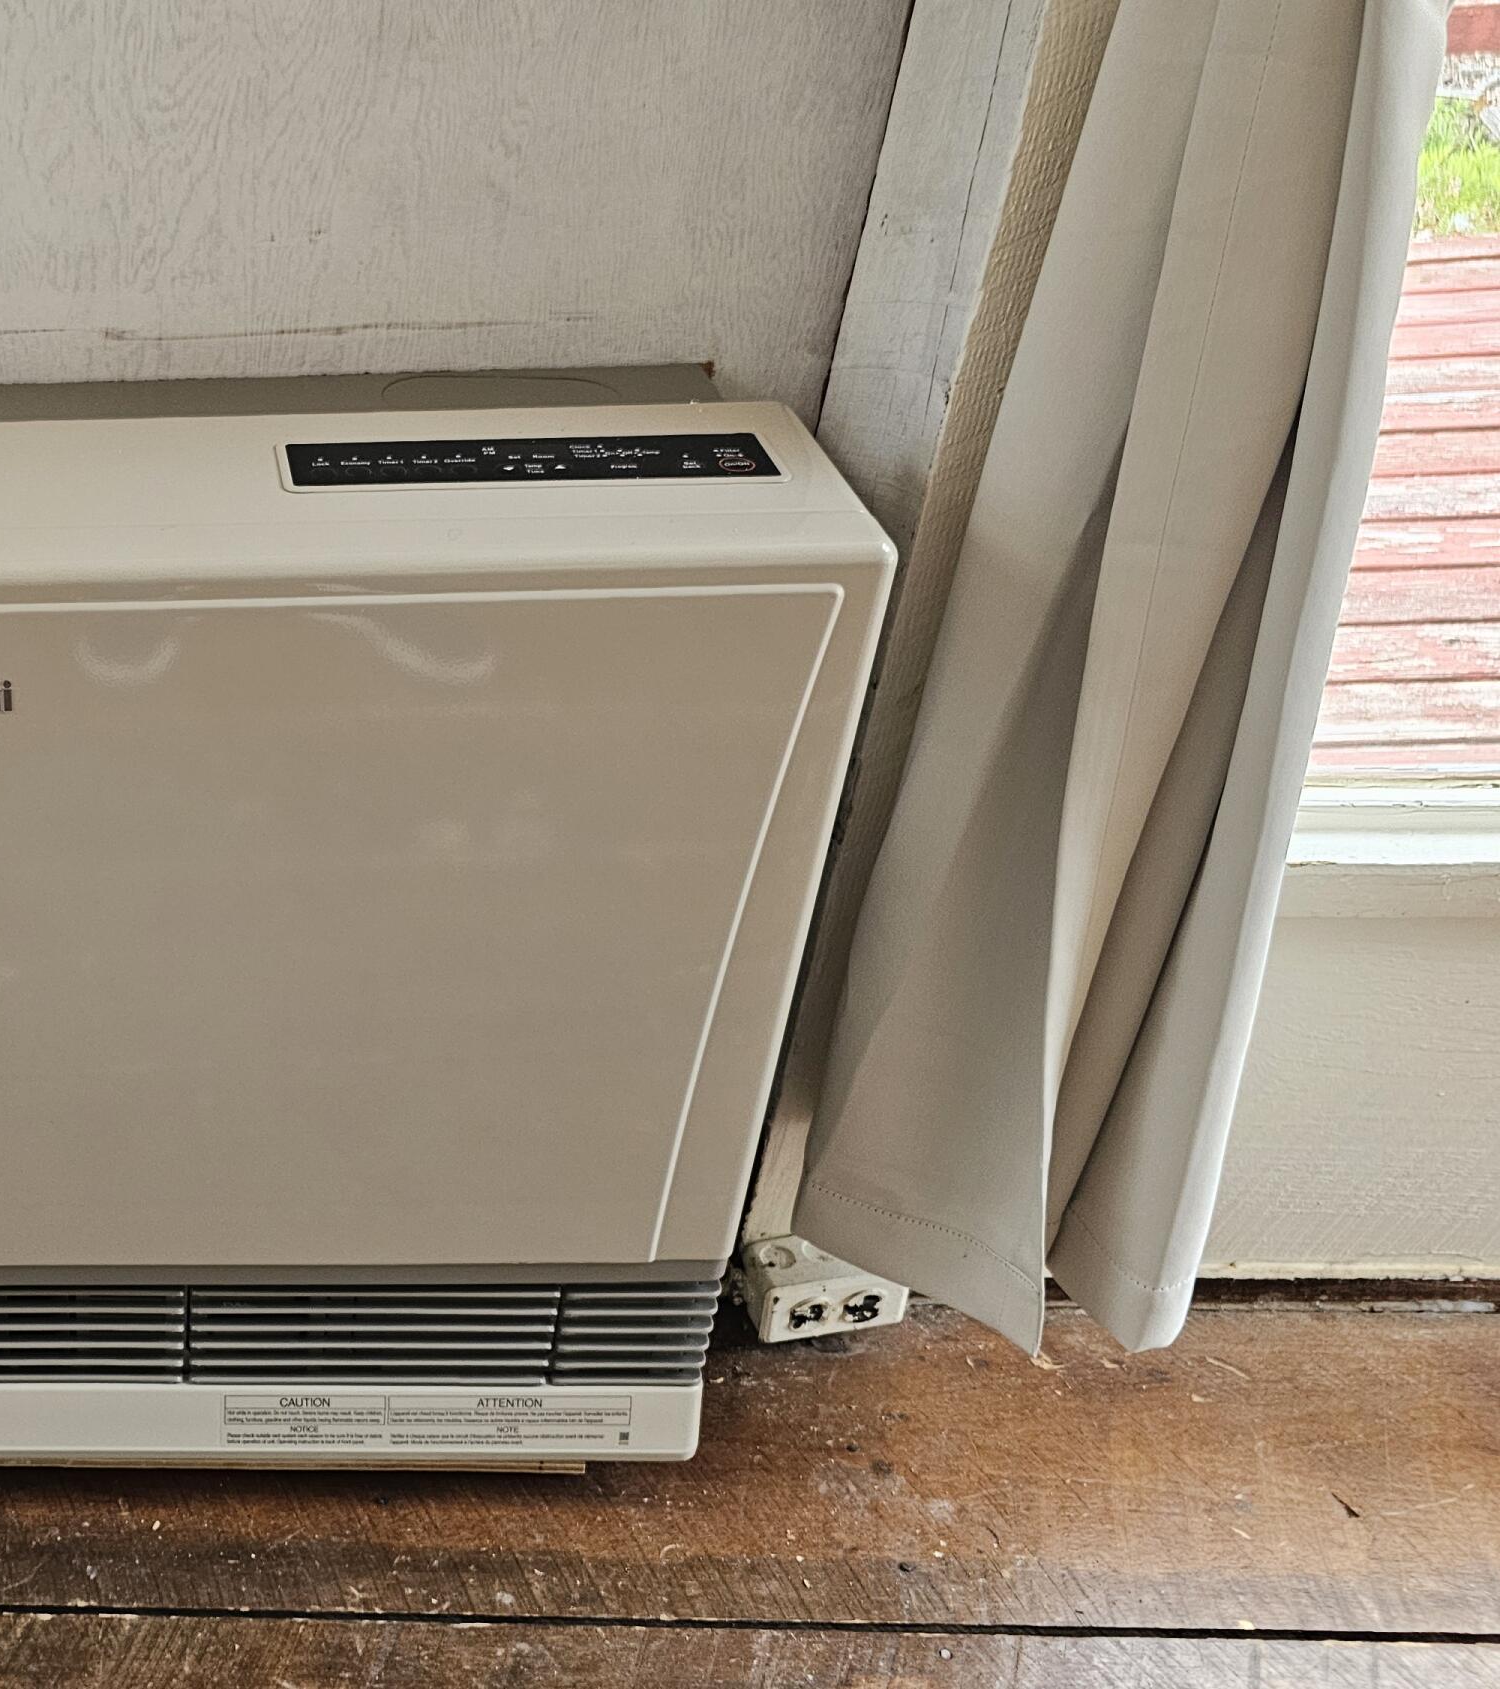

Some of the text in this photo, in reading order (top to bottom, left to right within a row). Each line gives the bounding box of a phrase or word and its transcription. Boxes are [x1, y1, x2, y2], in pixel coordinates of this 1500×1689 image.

[279, 1397, 330, 1407] CAUTION
[477, 1397, 543, 1408] ATTENTION
[290, 1425, 319, 1433] NOTICE
